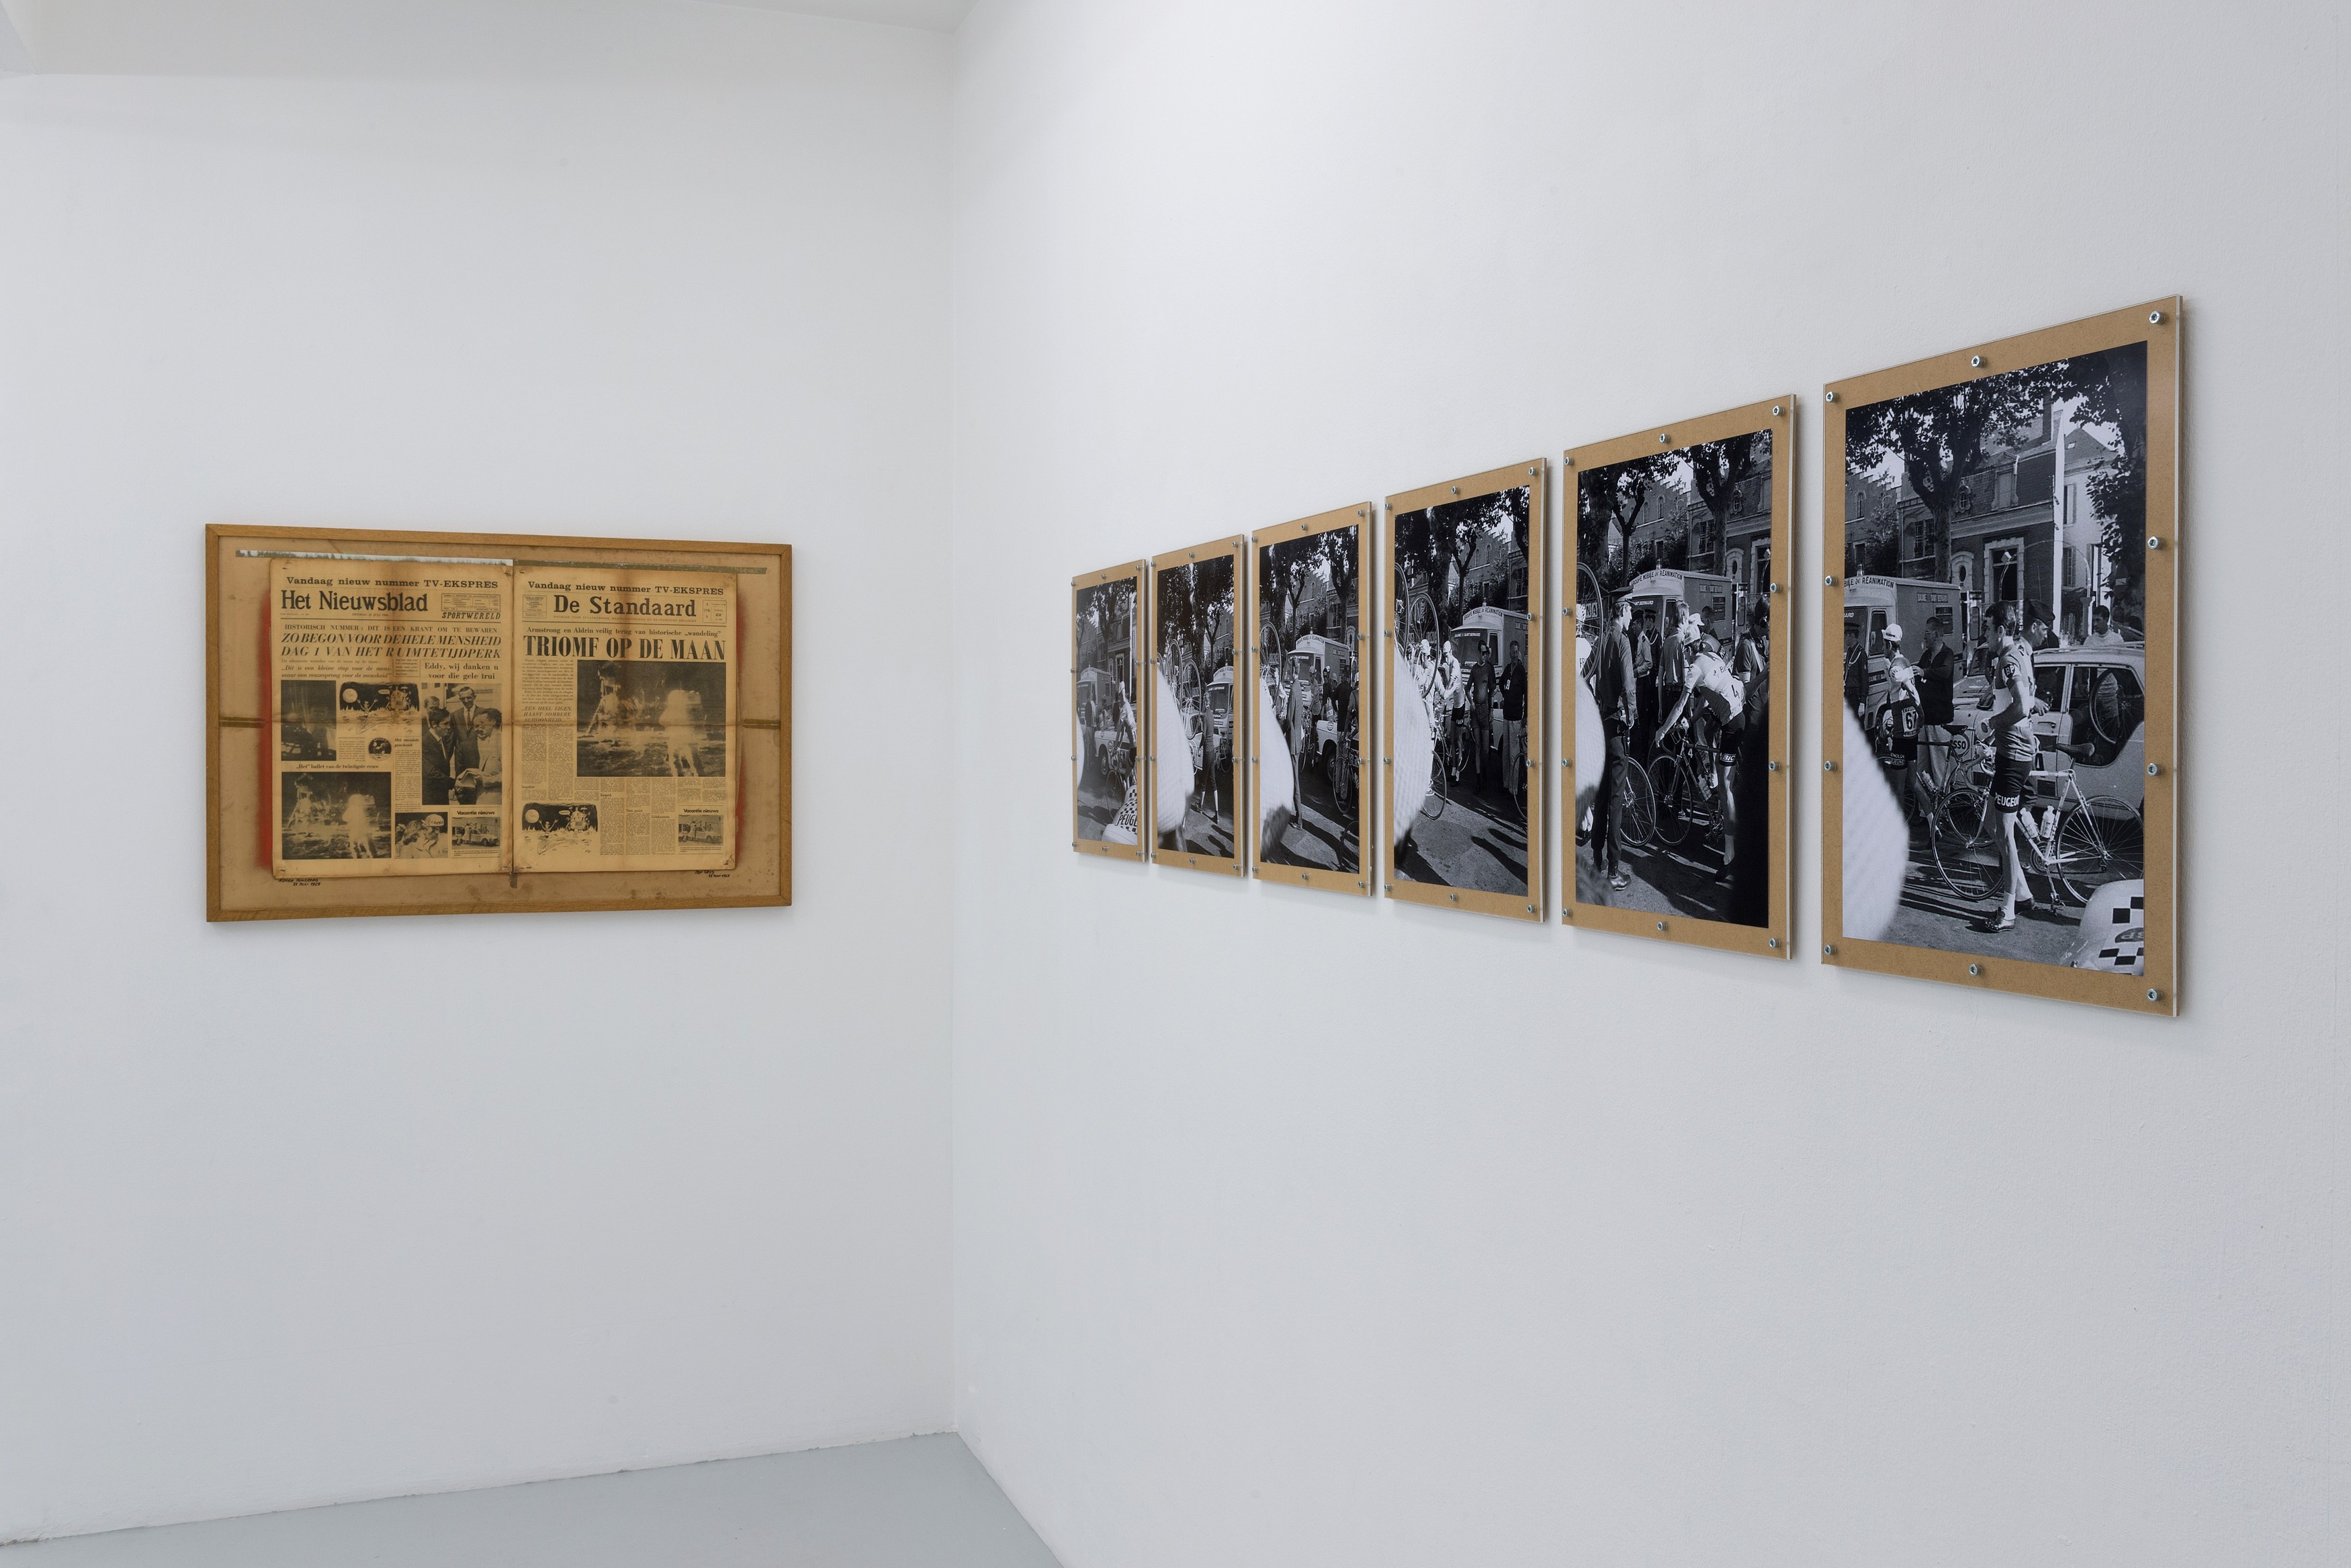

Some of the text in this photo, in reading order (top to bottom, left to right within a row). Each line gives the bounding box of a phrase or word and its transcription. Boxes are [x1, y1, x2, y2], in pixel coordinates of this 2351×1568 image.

[286, 576, 333, 586] Vandaag
[338, 578, 370, 586] nieuw
[424, 580, 498, 588] TV-EKSPRES
[528, 581, 571, 591] Vandaag
[576, 583, 605, 591] nieuw
[655, 586, 723, 596] TV-EKSPRES
[281, 590, 311, 610] Het
[319, 590, 428, 612] Nieuwsblad
[553, 594, 580, 613] De
[590, 596, 697, 617] Standaard
[441, 612, 501, 620] SPORTWERELD
[527, 627, 560, 635] Armstrong
[281, 633, 501, 646] ZO BEGON VOOR DE HELE MENSHEID
[281, 646, 309, 656] DAG
[314, 647, 319, 656] 1
[326, 647, 353, 656] VAN
[355, 647, 383, 657] HET
[523, 635, 726, 660] TRIOMF OP DE MAAN
[449, 663, 460, 671] wij
[463, 662, 490, 670] danken
[2005, 666, 2015, 676] BP
[463, 672, 478, 680] gele
[1905, 711, 1917, 729] 67
[1953, 740, 1966, 749] SSO
[1687, 748, 1693, 758] 4
[1995, 792, 2020, 807] PEUGEO
